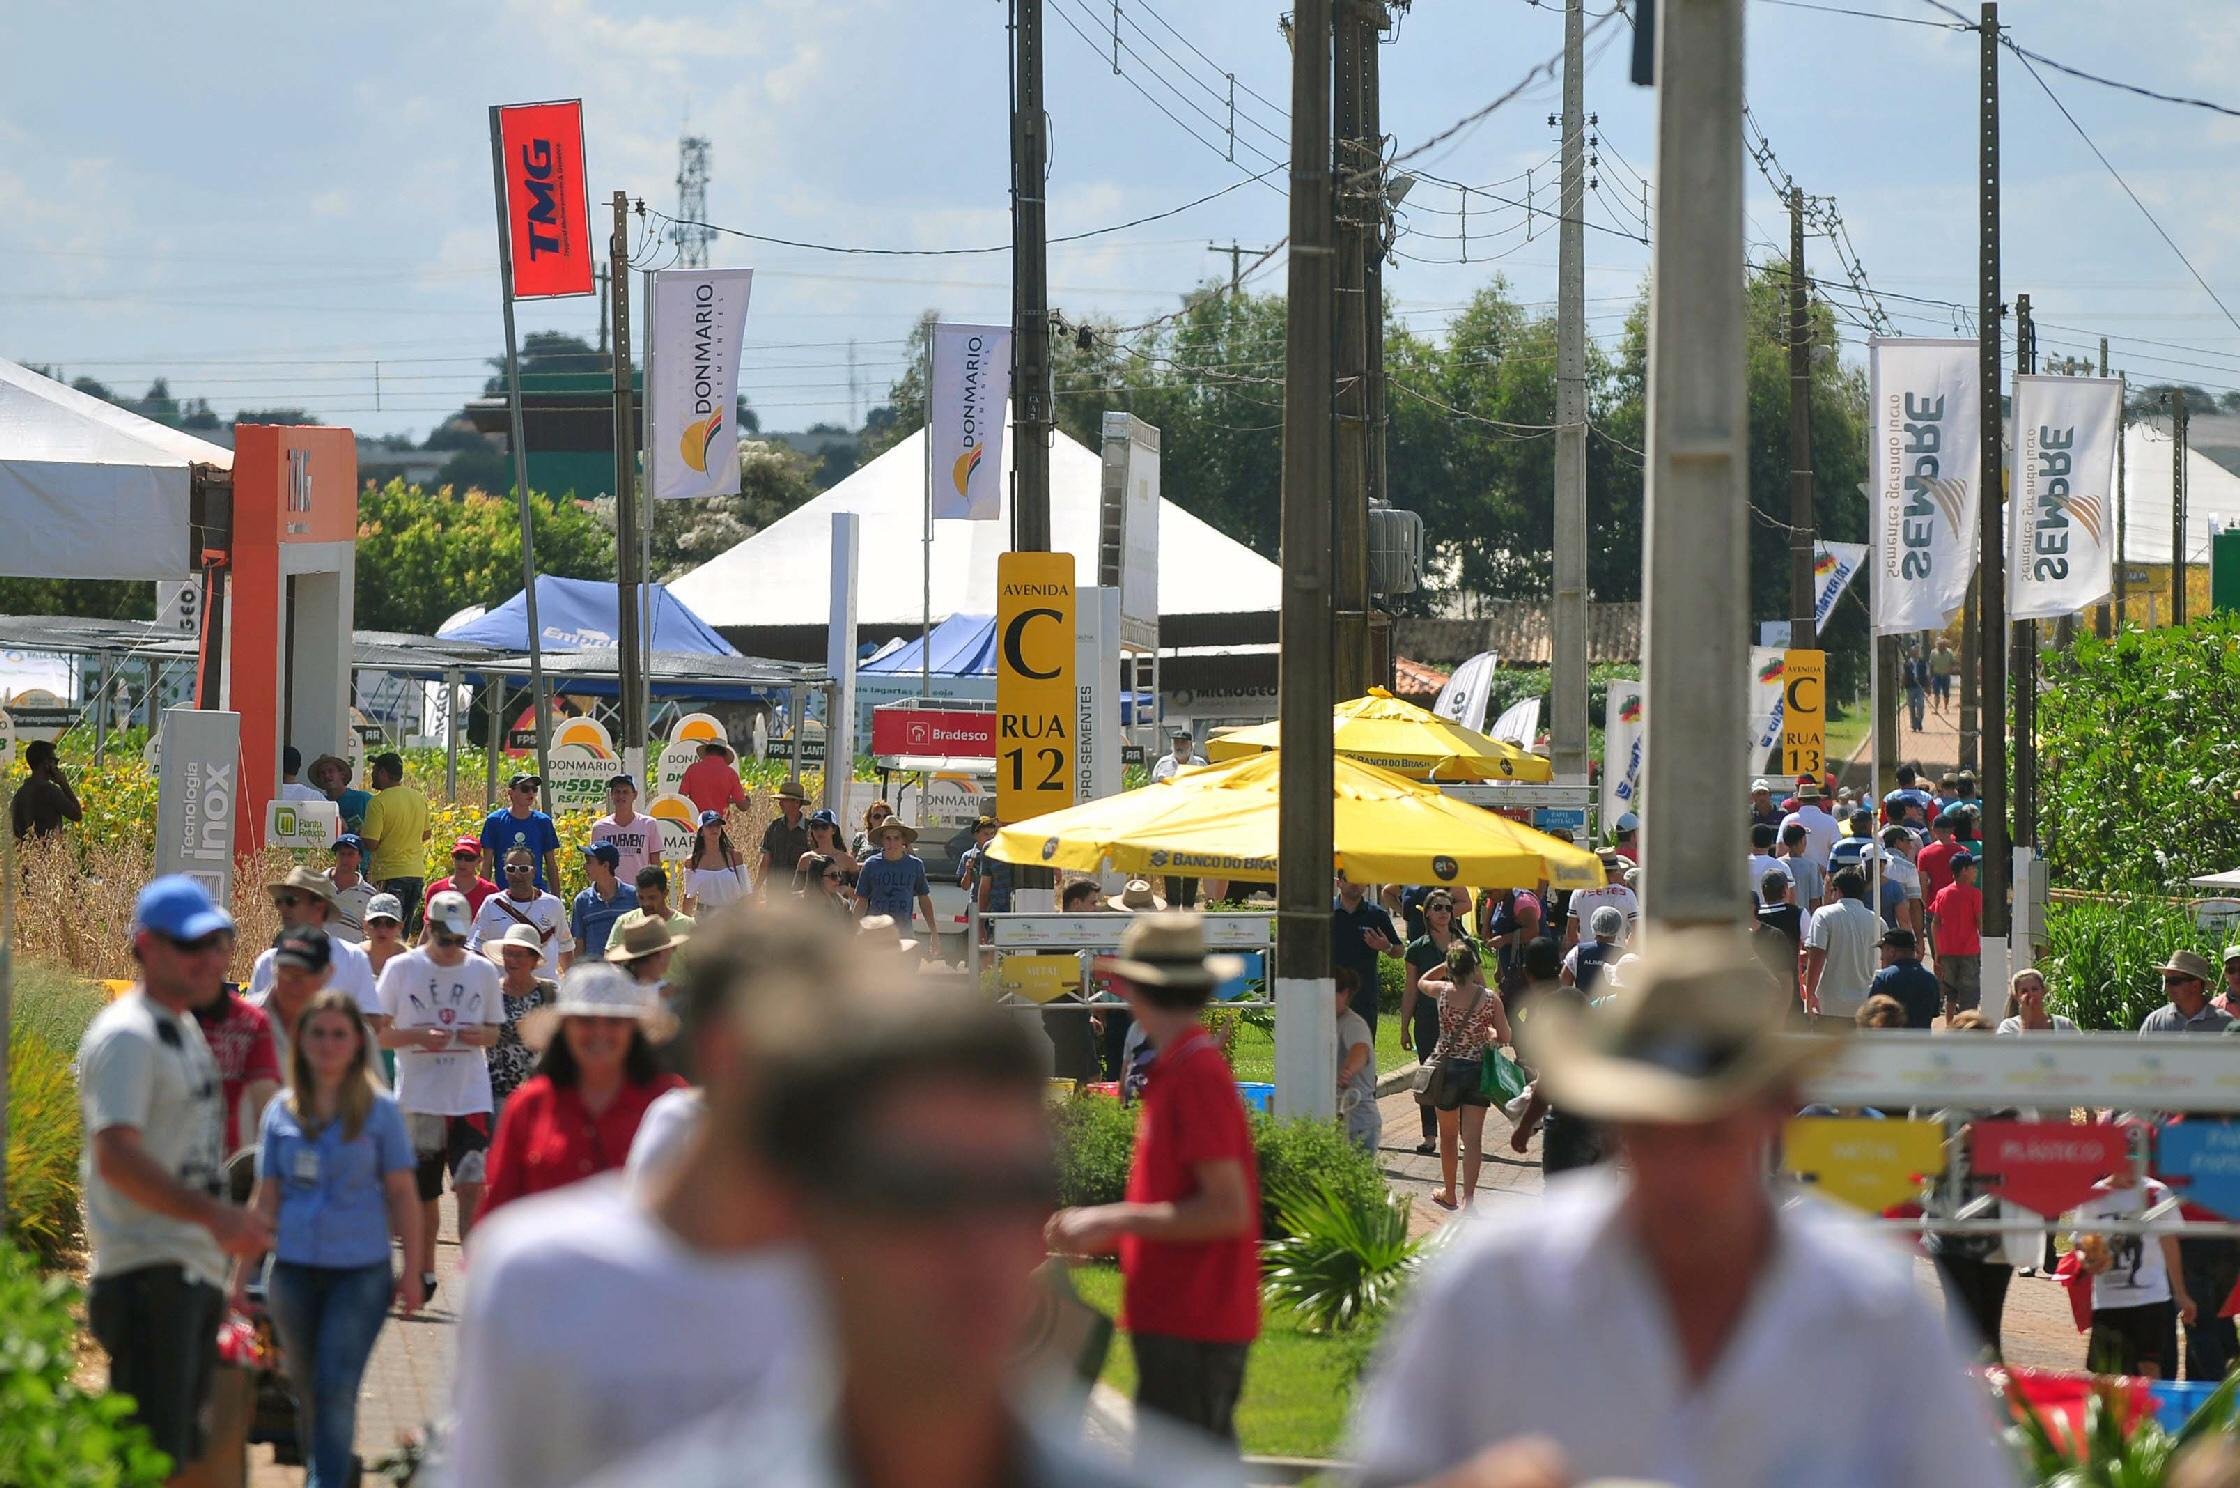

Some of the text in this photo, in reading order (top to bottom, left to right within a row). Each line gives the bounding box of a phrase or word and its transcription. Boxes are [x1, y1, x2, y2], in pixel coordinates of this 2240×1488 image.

[523, 139, 560, 262] TMG
[694, 284, 714, 415] DONMARIO
[716, 297, 724, 399] SEMENTES
[963, 337, 982, 448] DONMARIO
[1003, 584, 1069, 596] AVENIDA
[1004, 608, 1064, 680] C
[1788, 666, 1822, 674] AVENIDA
[1787, 677, 1818, 713] C
[932, 729, 988, 742] Bradesco
[1001, 714, 1066, 739] RUA
[768, 743, 784, 755] FPS
[1787, 733, 1821, 745] RUA
[548, 760, 617, 771] DONMARIO
[1004, 747, 1065, 791] 12
[1357, 756, 1388, 766] BANCO
[1787, 750, 1820, 772] 13
[180, 761, 200, 859] Tecnologia
[1172, 852, 1220, 868] BANCO
[1222, 856, 1242, 868] DO
